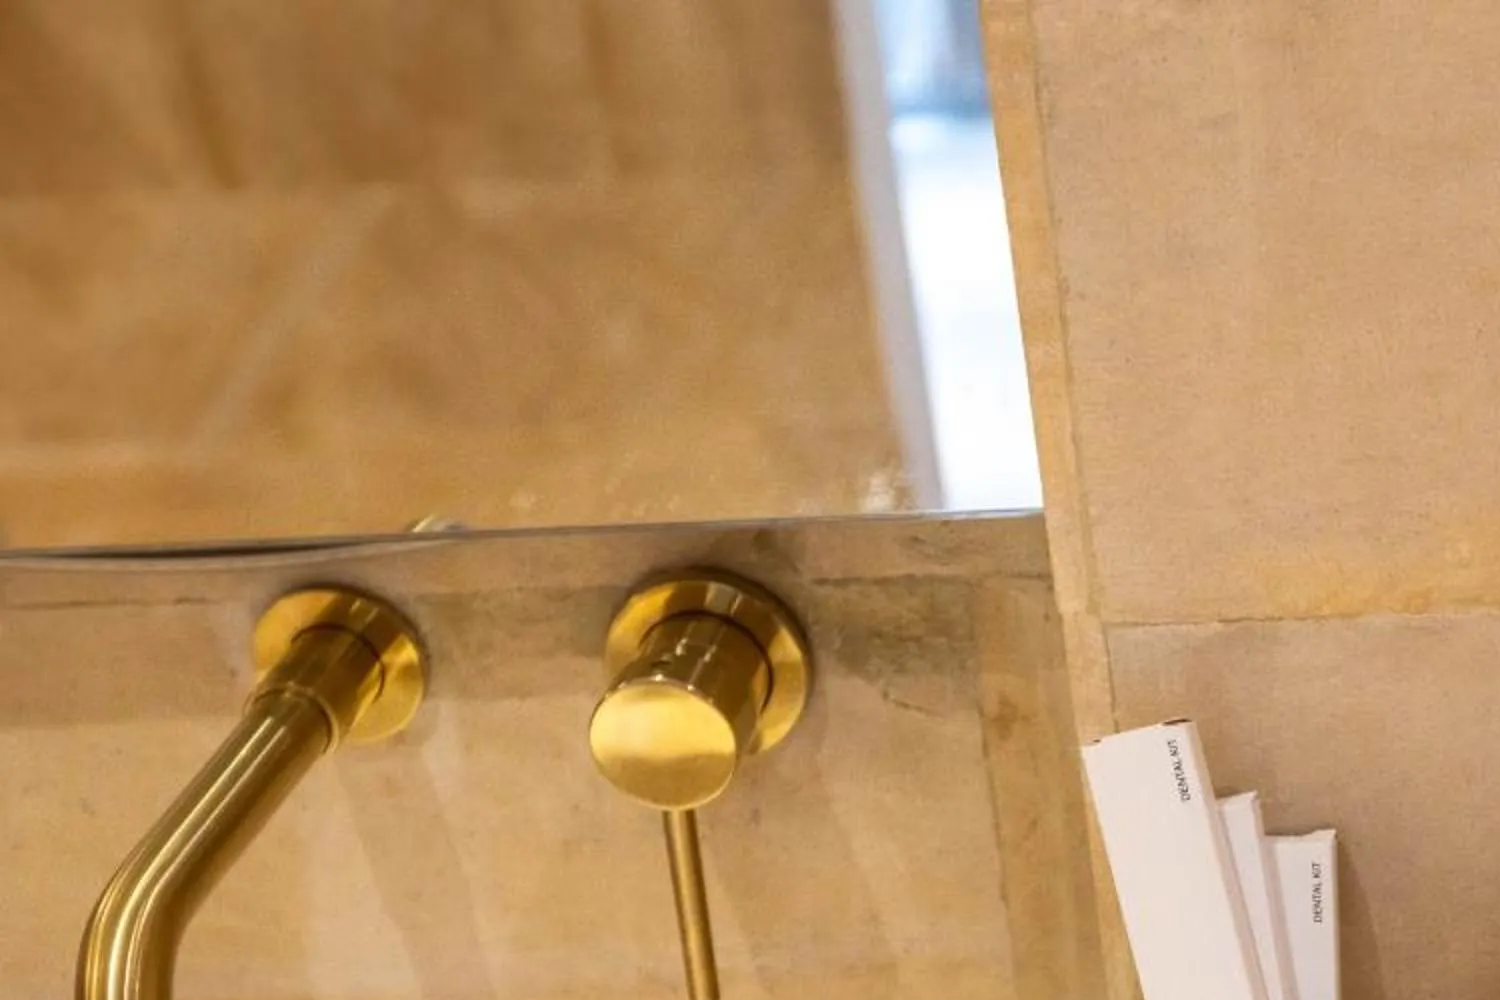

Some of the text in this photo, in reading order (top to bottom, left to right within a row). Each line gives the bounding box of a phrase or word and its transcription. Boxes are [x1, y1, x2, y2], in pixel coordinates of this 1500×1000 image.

[1167, 738, 1191, 802] DENTAL KIT
[1311, 862, 1323, 923] DENTAL KIT
